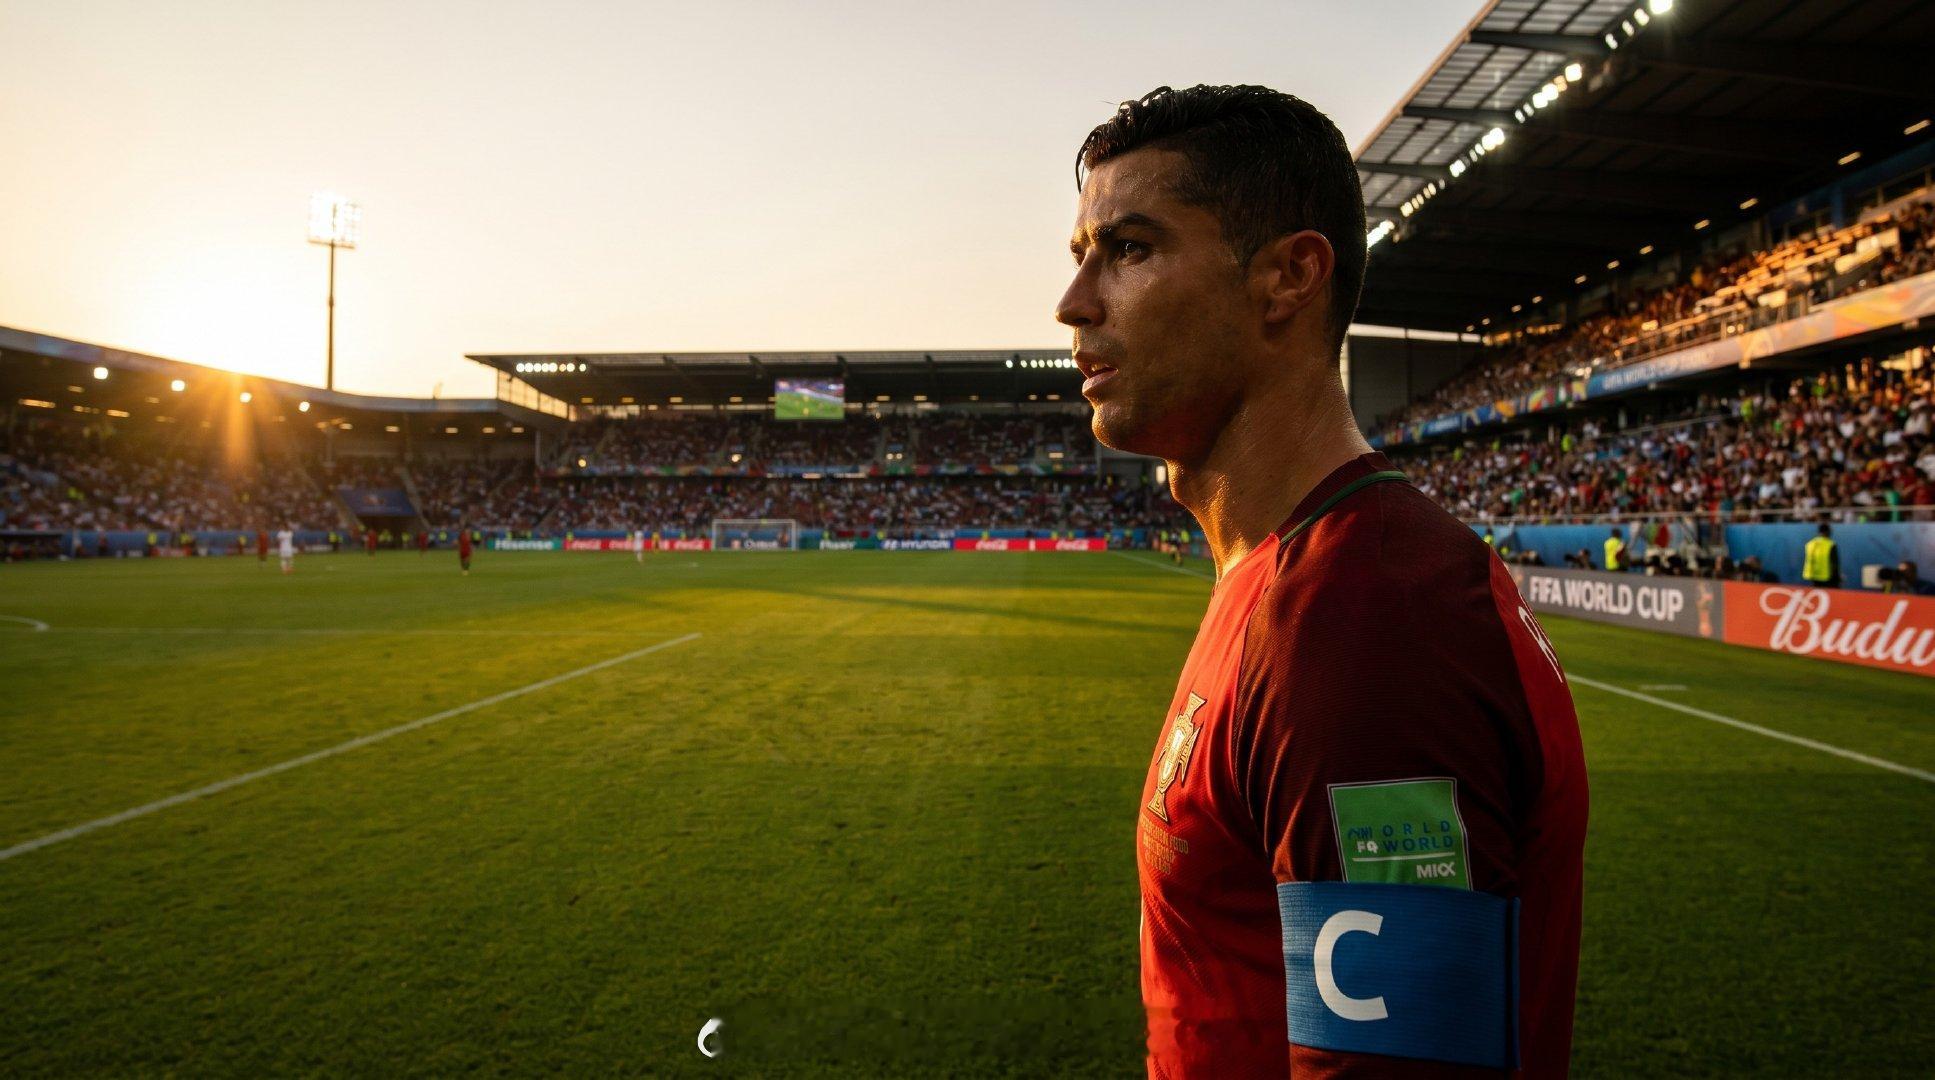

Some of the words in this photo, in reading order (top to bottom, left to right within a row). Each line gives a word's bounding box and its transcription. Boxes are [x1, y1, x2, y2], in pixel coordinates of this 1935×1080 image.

[1529, 576, 1563, 606] FIFA
[1564, 579, 1633, 616] WORLD
[1636, 586, 1684, 622] CUP
[1382, 836, 1454, 853] WORLD
[1314, 910, 1389, 1021] C
